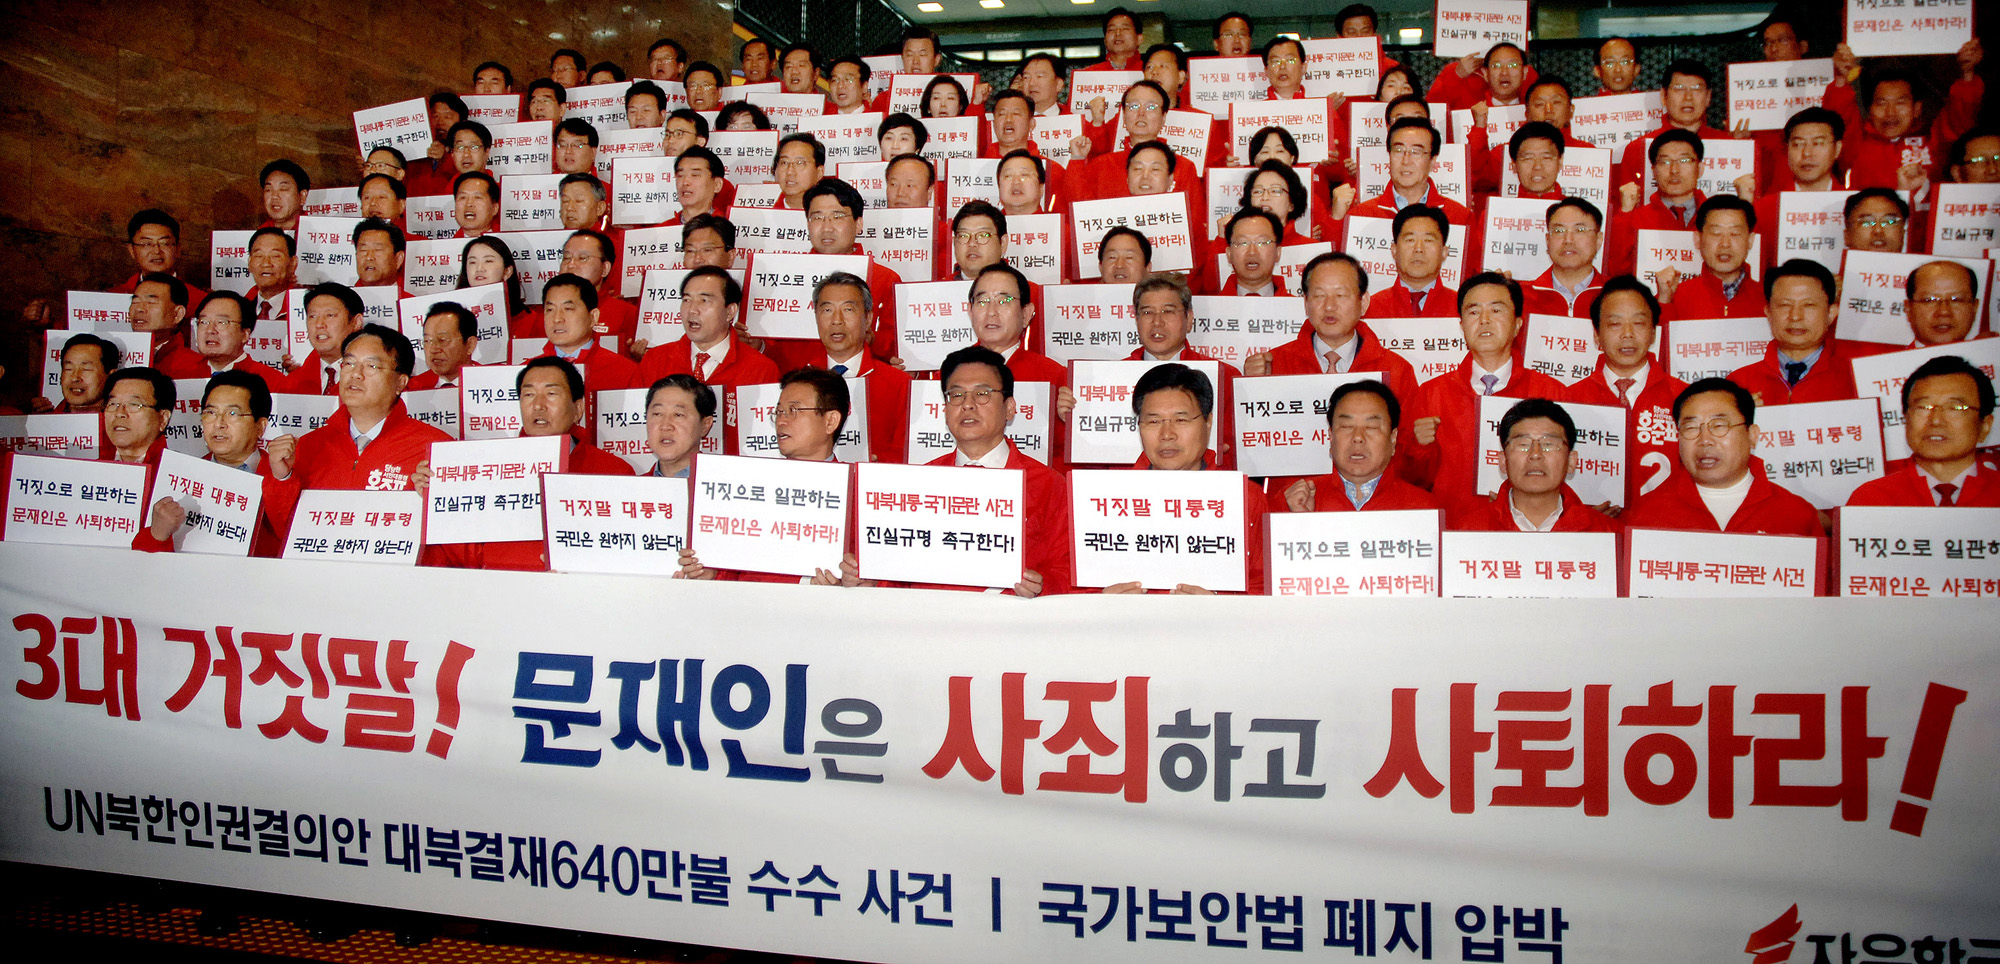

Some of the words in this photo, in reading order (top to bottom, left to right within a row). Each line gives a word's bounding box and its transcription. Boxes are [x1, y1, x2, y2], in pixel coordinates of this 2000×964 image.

[1507, 13, 1522, 25] 사건
[1853, 20, 1904, 33] 문재인은
[1911, 17, 1967, 31] 사퇴하라!
[1440, 28, 1478, 41] 진실규명
[1482, 29, 1523, 43] 촉구한다!
[1358, 51, 1373, 61] 사건
[1199, 72, 1230, 83] 거짓말
[1237, 71, 1268, 82] 대통령
[1336, 68, 1375, 79] 촉구한다!
[1734, 79, 1779, 91] 거짓으로
[1784, 76, 1829, 88] 일관하는
[1196, 91, 1219, 101] 국민은
[1222, 91, 1245, 101] 원하지
[805, 108, 819, 116] 사건
[1734, 98, 1777, 111] 문재인은
[411, 113, 425, 124] 사건
[504, 108, 516, 117] 사건
[1306, 114, 1323, 125] 사건
[1647, 107, 1664, 120] 사건
[535, 135, 548, 145] 사건
[843, 127, 873, 138] 대통령
[938, 131, 968, 142] 대통령
[1041, 129, 1072, 139] 대통령
[1188, 128, 1204, 139] 사건
[1577, 131, 1617, 144] 진실규명
[363, 138, 393, 152] 진실규명
[396, 130, 429, 146] 촉구한다!
[1357, 136, 1382, 147] 국민은
[513, 152, 549, 164] 촉구한다!
[737, 146, 773, 157] 일관하는
[828, 147, 850, 157] 원하지
[853, 146, 877, 156] 않는다!
[948, 150, 972, 159] 않는다!
[735, 165, 773, 176] 사퇴하라!
[1586, 166, 1604, 178] 사건
[623, 173, 655, 184] 거짓말
[952, 175, 993, 188] 거짓으로
[510, 189, 542, 200] 거짓말
[618, 192, 642, 203] 국민은
[646, 192, 669, 203] 원하지
[414, 210, 444, 221] 거짓말
[505, 209, 529, 220] 국민은
[532, 209, 555, 220] 원하지
[1079, 217, 1127, 231] 거짓으로
[1134, 212, 1183, 227] 일관하는
[307, 232, 340, 244] 거짓말
[883, 226, 928, 239] 일관하는
[1010, 232, 1048, 245] 대통령
[1941, 228, 1994, 241] 진실규명
[627, 243, 668, 256] 거짓으로
[1491, 240, 1538, 255] 진실규명
[1785, 237, 1835, 250] 진실규명
[301, 253, 325, 264] 국민은
[328, 254, 352, 265] 원하지
[415, 255, 450, 267] 거짓말
[881, 250, 928, 262] 사퇴하라!
[1024, 255, 1055, 268] 않는다!
[1650, 248, 1694, 261] 거짓말
[409, 276, 436, 287] 국민은
[756, 273, 804, 287] 거짓으로
[1859, 272, 1907, 289] 거짓말
[752, 298, 800, 312] 문재인은
[908, 303, 952, 318] 거짓말
[1056, 305, 1101, 320] 거짓말
[1848, 298, 1885, 315] 국민은
[643, 312, 682, 325] 문재인은
[1247, 319, 1302, 334] 일관하는
[904, 329, 936, 344] 국민은
[941, 328, 973, 343] 원하지
[1052, 331, 1085, 346] 국민은
[1089, 331, 1121, 346] 원하지
[1541, 335, 1588, 353] 거짓말
[126, 352, 144, 365] 사건
[1531, 360, 1566, 377] 국민은
[468, 388, 520, 403] 거짓으로
[1240, 400, 1304, 417] 거짓으로
[469, 416, 520, 431] 문재인은
[1078, 415, 1138, 432] 진실규명
[1637, 409, 1679, 446] 홍준표
[917, 431, 954, 448] 국민은
[1242, 430, 1303, 447] 문재인은
[1807, 424, 1862, 445] 대통령
[72, 435, 94, 450] 사건
[603, 440, 652, 455] 문재인은
[745, 435, 778, 451] 국민은
[1640, 451, 1671, 496] 2
[1783, 460, 1823, 478] 원하지
[1830, 457, 1875, 476] 않는다!
[16, 478, 72, 497] 거짓으로
[81, 485, 137, 504] 일관하는
[168, 473, 203, 498] 거짓말
[211, 486, 249, 511] 대통령
[701, 482, 766, 502] 거짓으로
[775, 487, 841, 509] 일관하는
[434, 495, 486, 512] 진실규명
[559, 500, 611, 517] 거짓말
[622, 501, 673, 519] 대통령
[985, 498, 1014, 517] 사건
[1090, 498, 1151, 517] 거짓말
[1164, 499, 1225, 518] 대통령
[12, 507, 68, 527] 문재인은
[76, 513, 135, 533] 사퇴하라!
[186, 510, 213, 533] 원하지
[217, 520, 248, 543] 않는다!
[308, 511, 355, 526] 거짓말
[364, 511, 412, 527] 대통령
[699, 515, 762, 537] 문재인은
[770, 521, 839, 543] 사퇴하라!
[293, 538, 328, 554] 국민은
[333, 539, 368, 554] 원하지
[374, 540, 413, 555] 않는다!
[555, 530, 594, 548] 국민은
[599, 532, 636, 550] 원하지
[641, 533, 683, 551] 않는다!
[866, 526, 931, 548] 진실규명
[942, 531, 1015, 553] 촉구한다!
[1084, 533, 1128, 552] 국민은
[1135, 534, 1179, 553] 원하지
[1186, 535, 1235, 554] 않는다!
[1278, 541, 1350, 561] 거짓으로
[1360, 539, 1433, 559] 일관하는
[1849, 538, 1932, 558] 거짓으로
[1459, 559, 1522, 579] 거짓말
[1535, 560, 1597, 580] 대통령
[1772, 567, 1805, 587] 사건
[1278, 576, 1350, 596] 문재인은
[1359, 575, 1434, 595] 사퇴하라!
[1848, 575, 1930, 596] 문재인은
[12, 613, 141, 721] 3대
[163, 625, 476, 759] 거짓말!
[512, 651, 888, 783] 문재인은
[921, 673, 1327, 803] 사죄하고
[1363, 680, 1968, 837] 사퇴하라!
[42, 786, 371, 867] UN북한인권결의안
[384, 823, 731, 907] 대북결재640만불
[747, 859, 842, 916] 수수
[857, 868, 954, 927] 사건
[1038, 881, 1304, 952] 국가보안법
[1323, 897, 1433, 960] 폐지
[1454, 904, 1569, 964] 압박
